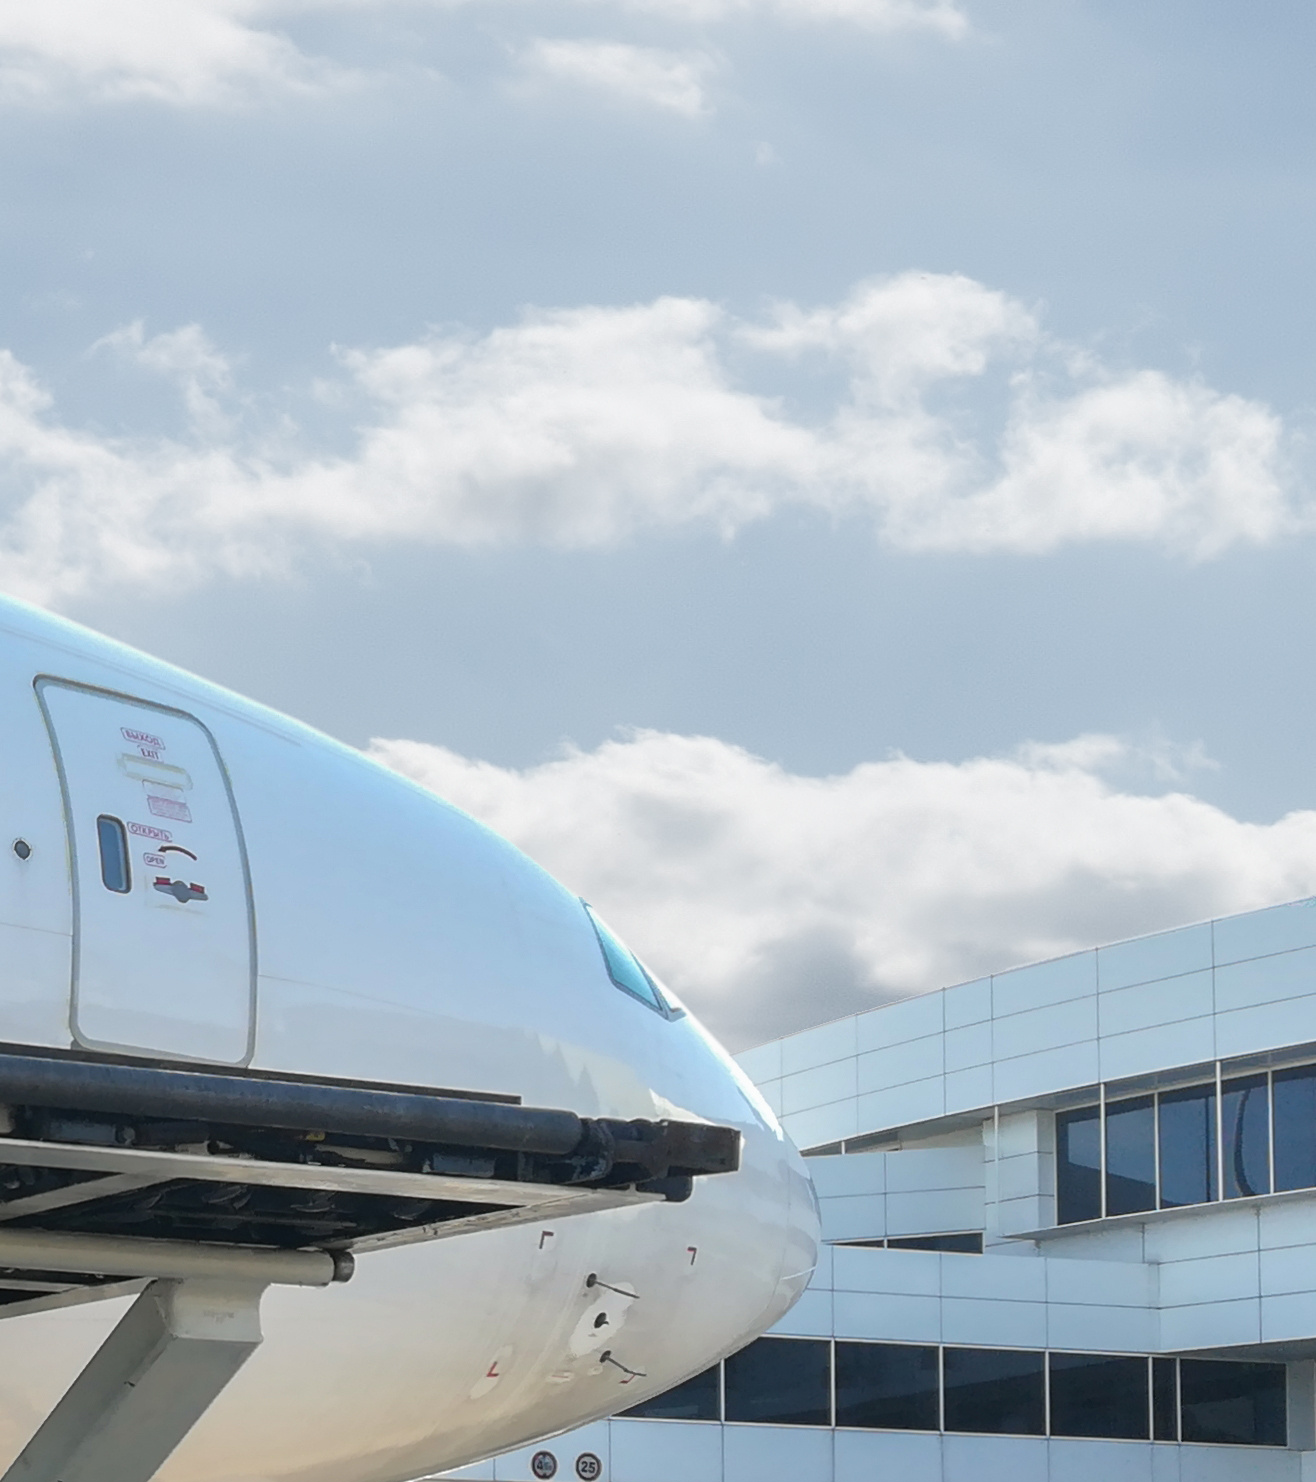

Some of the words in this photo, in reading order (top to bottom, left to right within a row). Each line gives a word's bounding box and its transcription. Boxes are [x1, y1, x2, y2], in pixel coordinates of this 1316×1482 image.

[125, 730, 161, 747] ВЫХОД
[140, 748, 159, 760] EXIT
[130, 824, 170, 841] ОТКРЫТЬ
[146, 856, 165, 866] OPEN
[580, 1460, 596, 1474] 25
